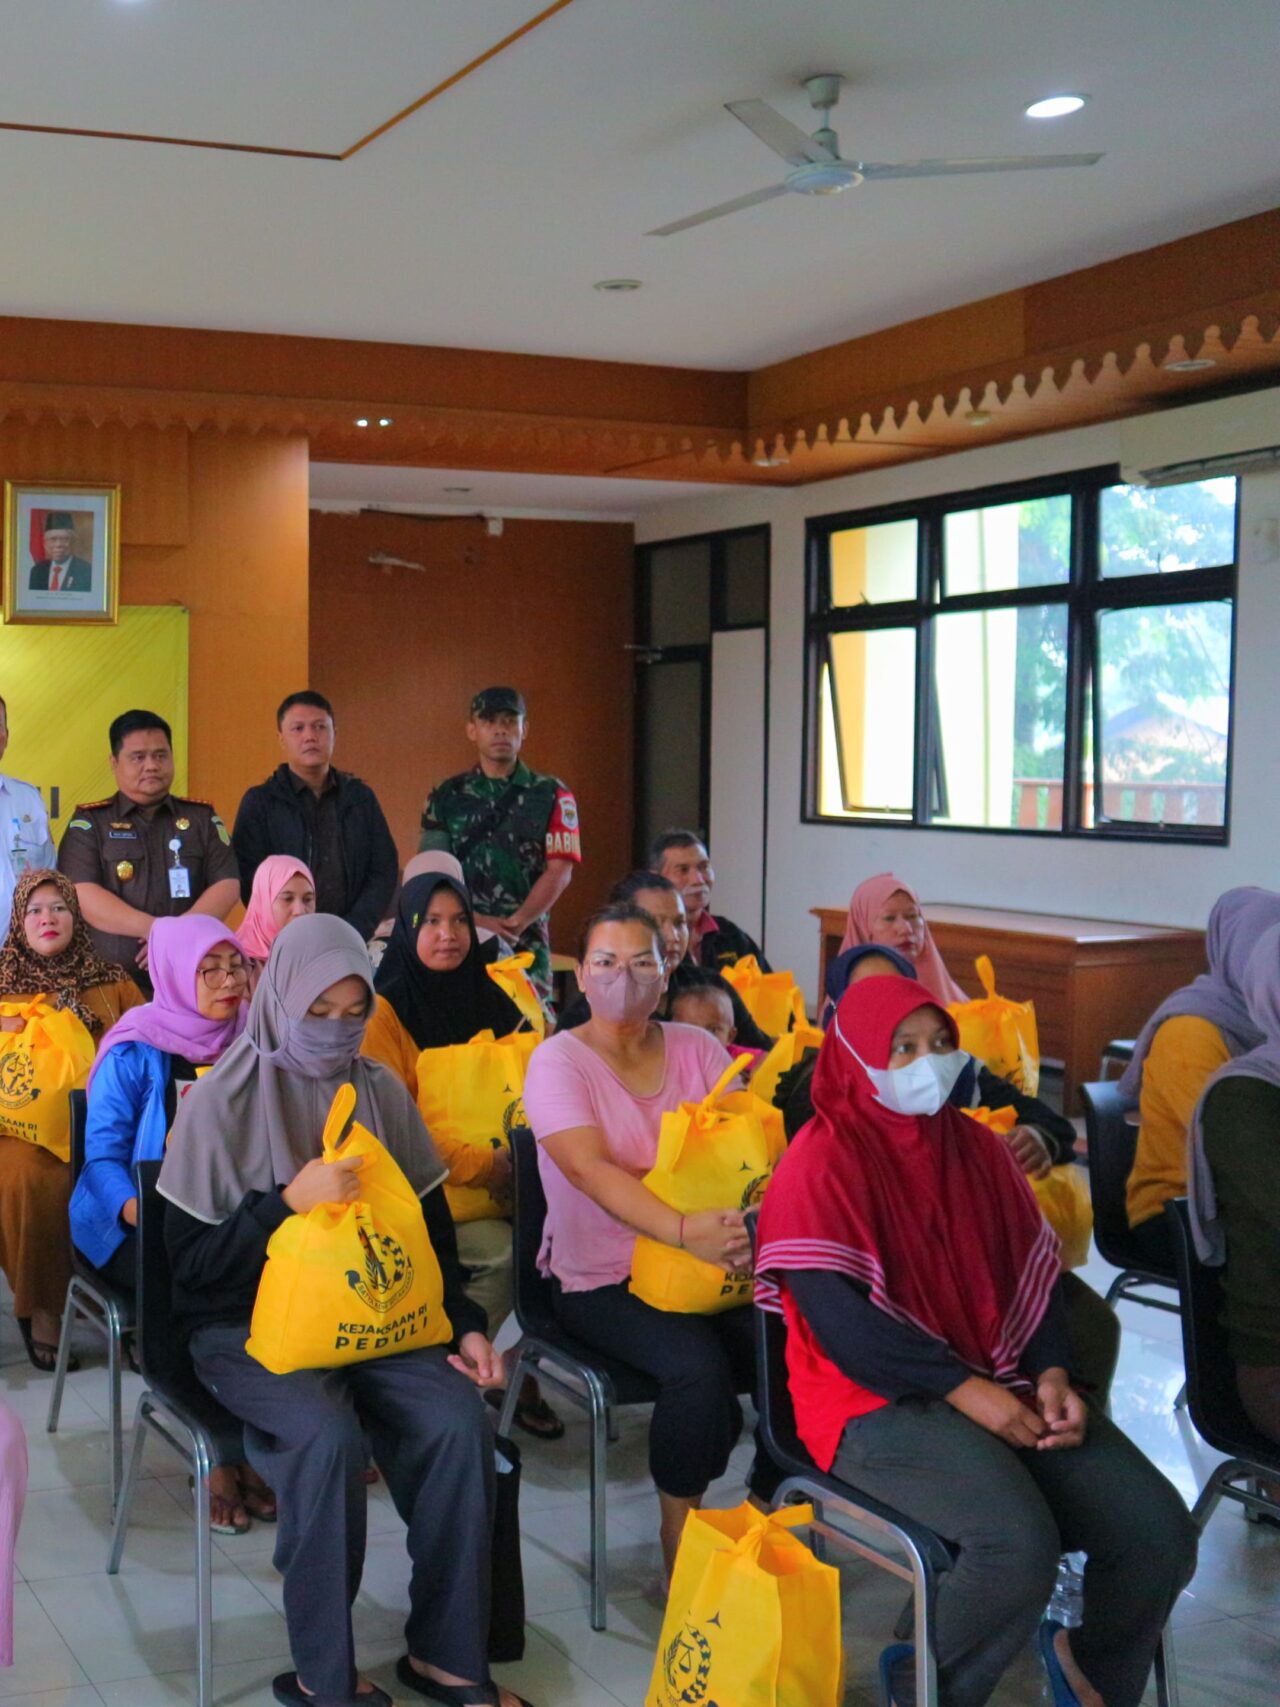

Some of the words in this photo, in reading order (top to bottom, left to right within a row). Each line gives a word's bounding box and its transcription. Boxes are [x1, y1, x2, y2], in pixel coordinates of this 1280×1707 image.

[335, 1315, 428, 1350] PEDULI
[337, 1311, 416, 1335] KEJAKSAAN
[418, 1302, 428, 1317] RI
